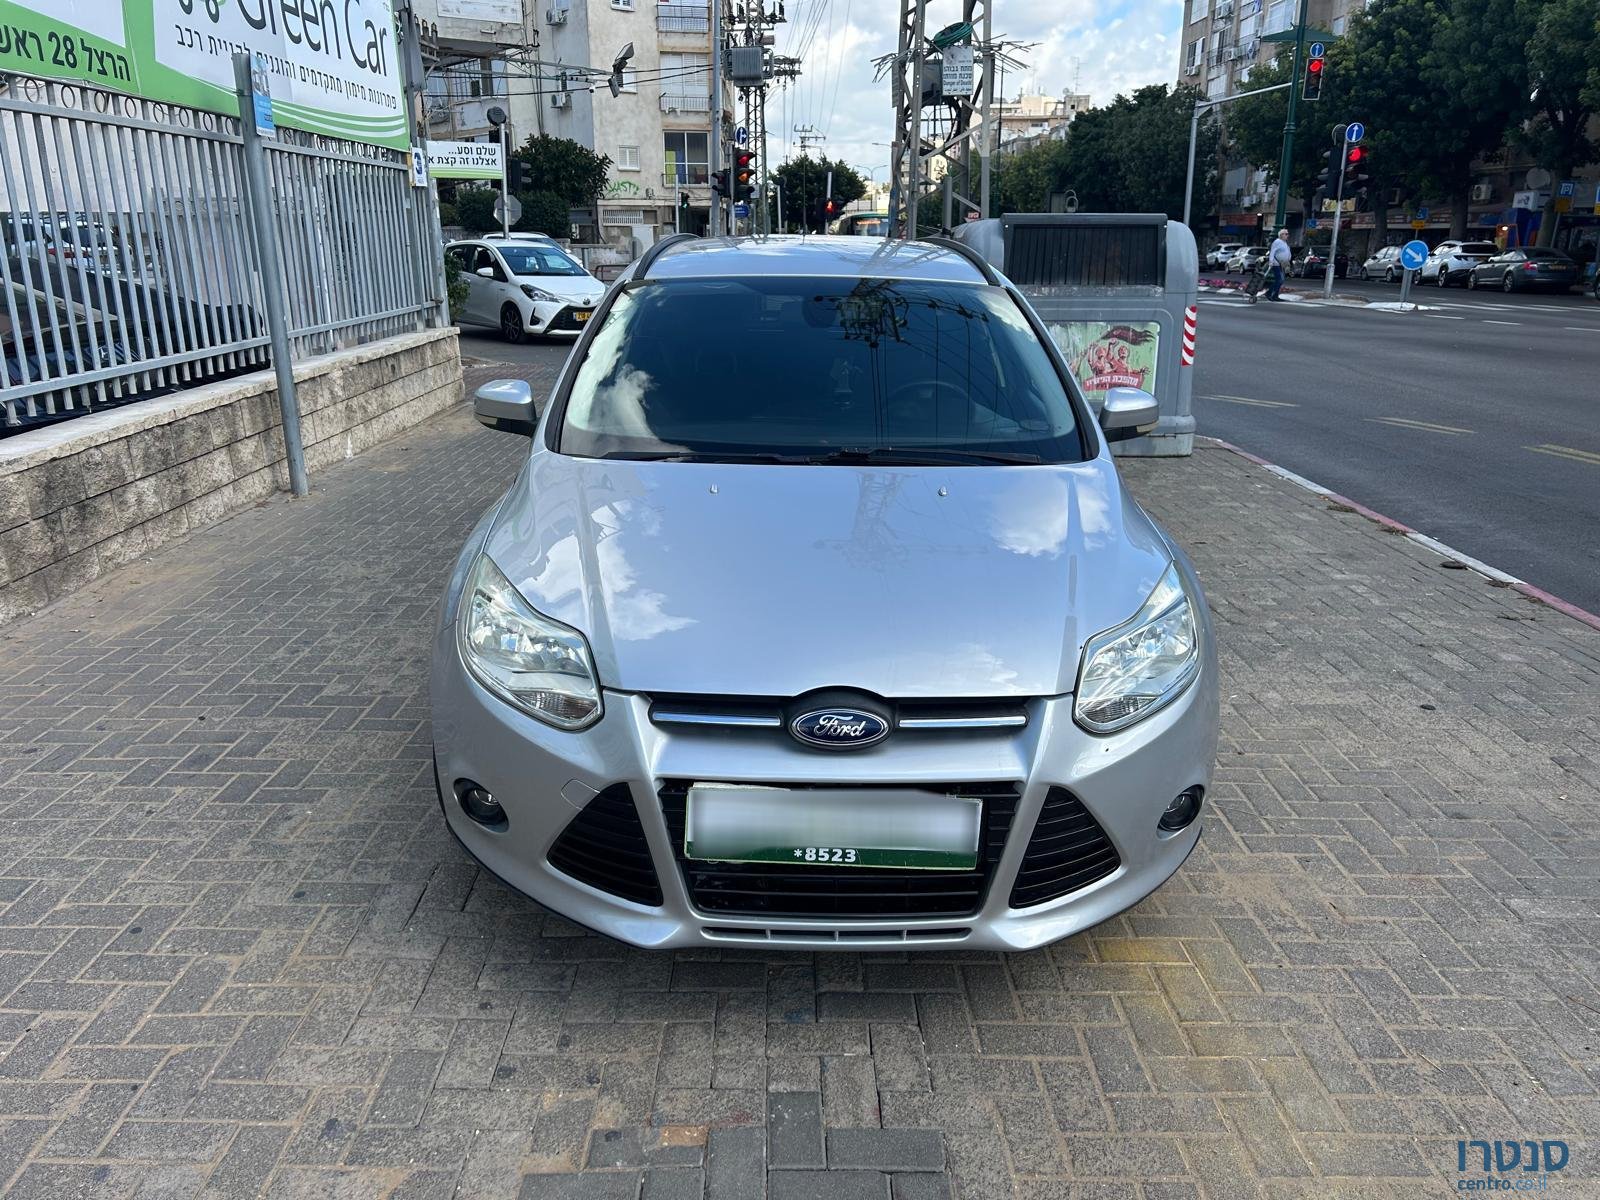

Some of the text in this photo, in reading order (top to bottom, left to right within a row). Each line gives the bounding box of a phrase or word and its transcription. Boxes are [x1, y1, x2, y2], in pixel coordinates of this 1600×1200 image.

[175, 24, 203, 52] רכב
[344, 0, 388, 77] Car
[47, 31, 78, 69] 28
[79, 37, 131, 82] הרצל
[299, 65, 343, 94] מתקדמים
[344, 79, 367, 100] מימון
[368, 87, 397, 110] פתרונות
[437, 156, 457, 167] קצת
[448, 146, 496, 156] שלם וסע...
[473, 156, 497, 166] אצלנו
[813, 714, 866, 737] Ford
